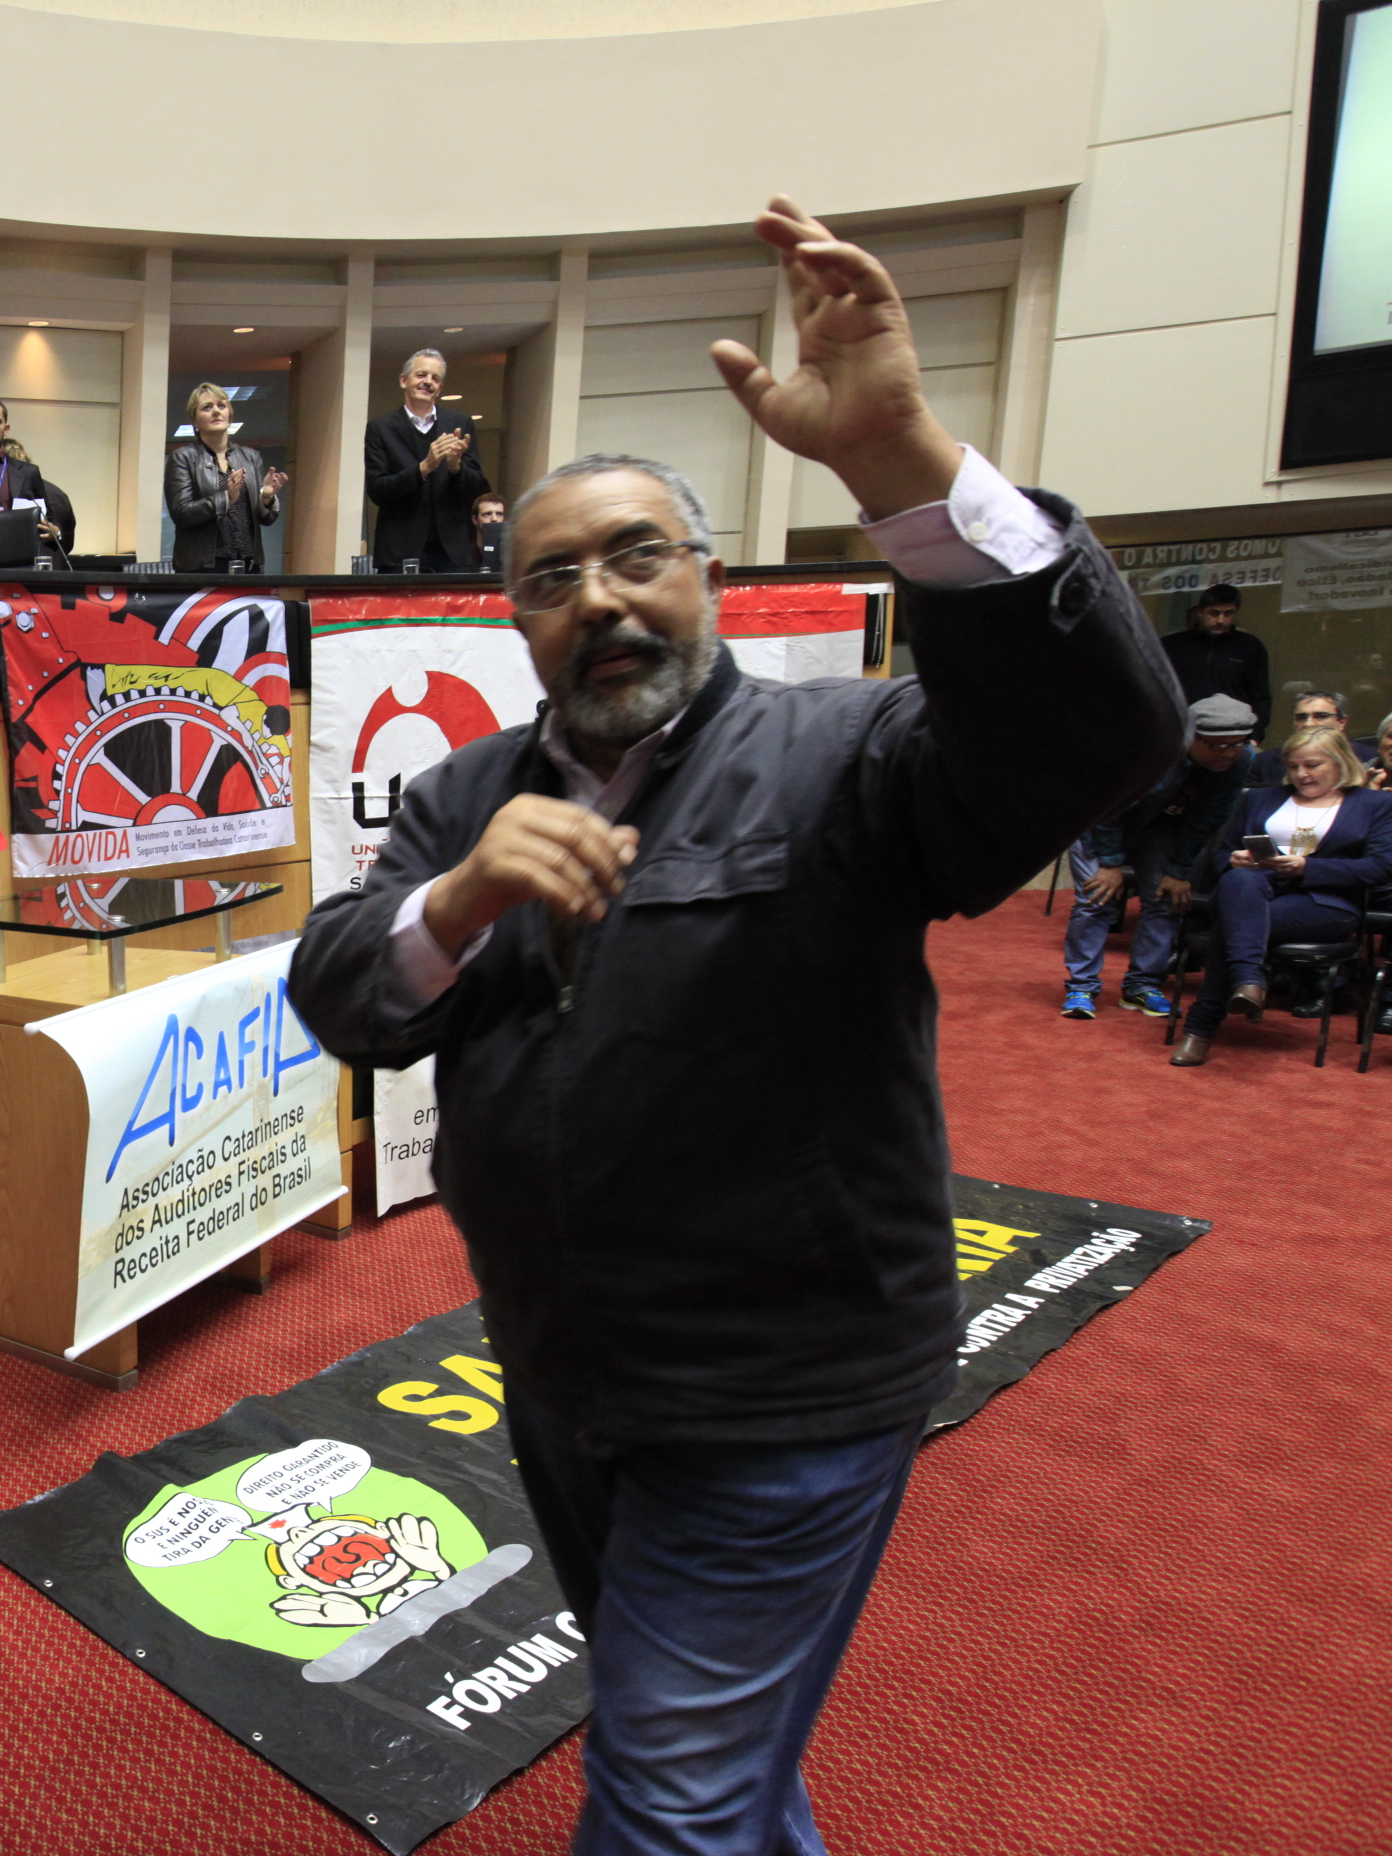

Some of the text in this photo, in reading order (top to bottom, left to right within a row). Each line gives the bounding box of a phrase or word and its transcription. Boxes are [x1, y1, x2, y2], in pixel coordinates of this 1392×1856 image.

[351, 772, 401, 829] U
[47, 829, 130, 866] MOVIDA
[135, 830, 169, 842] Movimento
[173, 829, 182, 837] em
[187, 826, 207, 836] Defesa
[212, 825, 219, 833] da
[119, 1105, 304, 1219] Associação Catarinense
[383, 1132, 437, 1164] Traba
[115, 1131, 307, 1254] dos Auditores Fiscais da
[114, 1156, 312, 1289] Receita Federal do Brasil
[1024, 1228, 1142, 1293] PRIVATIZAÇÃO
[1004, 1293, 1045, 1309] A
[243, 1441, 339, 1494] DIREITO GARANTIDO
[266, 1453, 348, 1498] NÃO SE COMPRA
[290, 1484, 316, 1500] NÃO
[313, 1478, 330, 1487] SE
[329, 1461, 362, 1481] VENDE
[134, 1536, 146, 1544] O
[145, 1526, 170, 1540] SUS
[167, 1517, 180, 1527] É
[162, 1547, 193, 1561] TIRA
[191, 1535, 211, 1549] DA
[426, 1633, 578, 1730] FÓRUM
